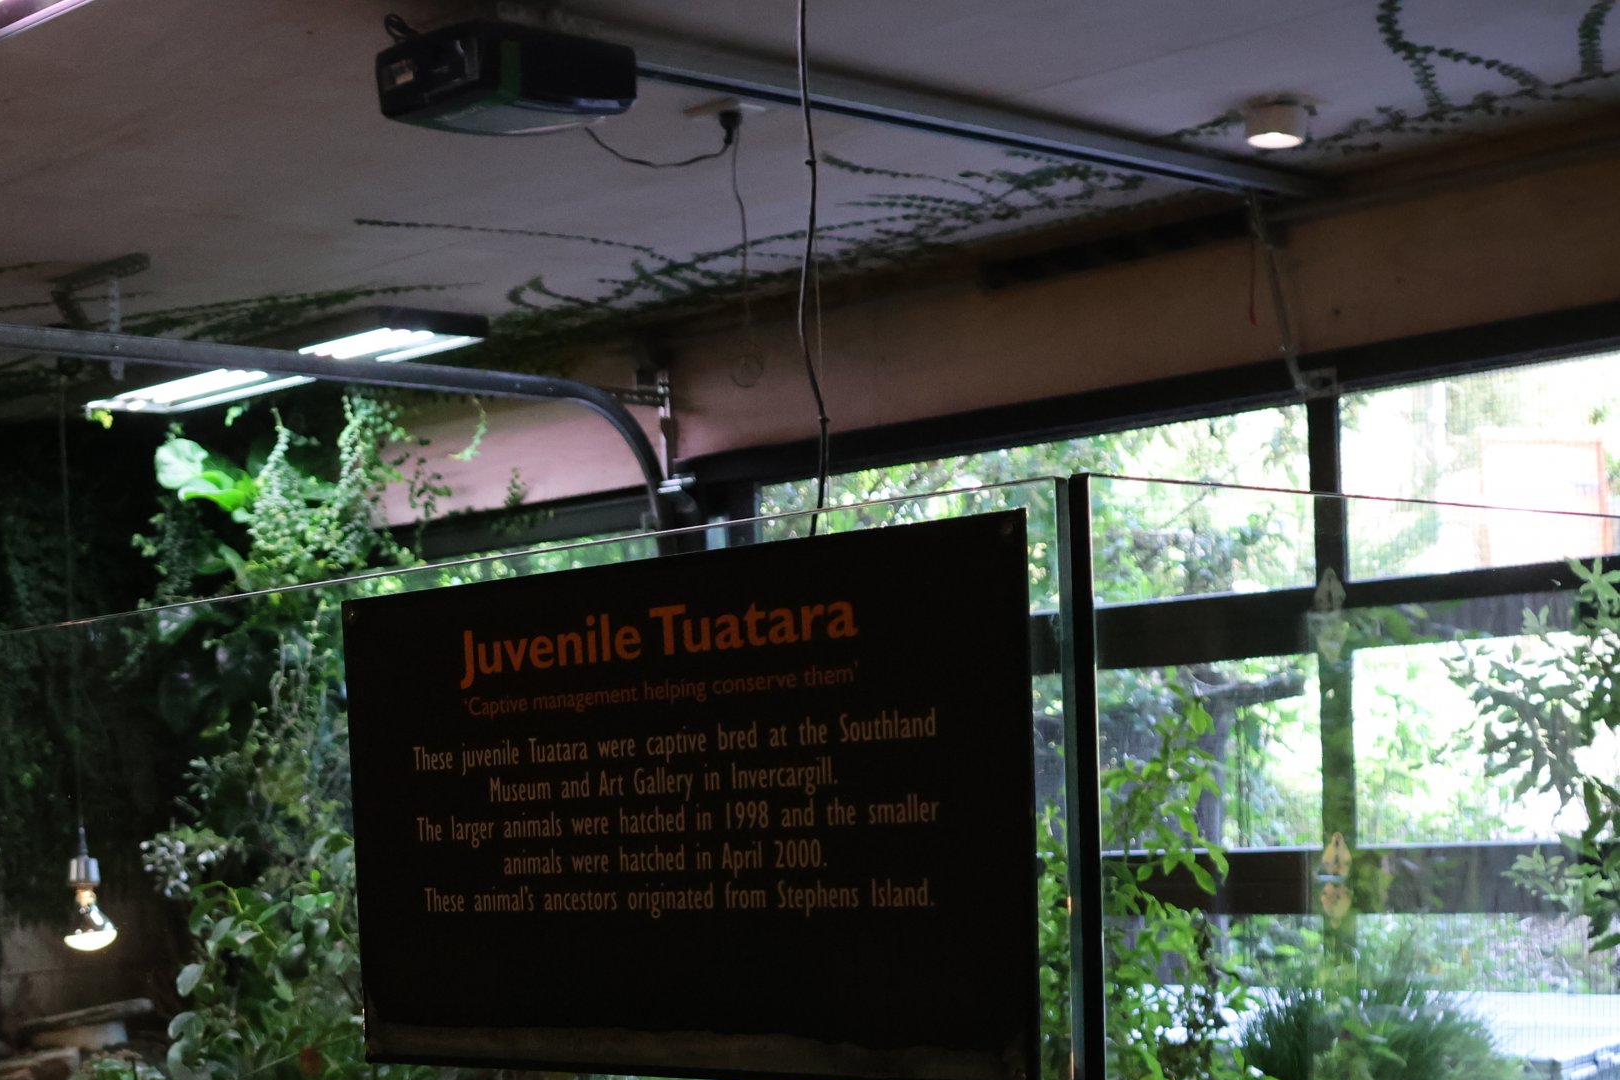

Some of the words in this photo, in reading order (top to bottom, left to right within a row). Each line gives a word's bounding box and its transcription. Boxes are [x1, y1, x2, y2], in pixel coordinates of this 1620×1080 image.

[459, 613, 642, 690] Juvenile
[648, 600, 859, 656] Tuatara
[532, 687, 639, 713] management
[643, 678, 707, 705] helping
[711, 672, 798, 695] conserve
[412, 745, 453, 771] These
[461, 739, 520, 777] juvenile
[527, 737, 589, 764] Tuatara
[596, 737, 636, 758] were
[645, 725, 707, 764] captive
[717, 720, 758, 752] bred
[769, 724, 788, 748] at
[797, 715, 828, 746] the
[839, 706, 937, 743] Southland
[489, 776, 552, 803] Museum
[560, 771, 590, 800] and
[598, 769, 624, 797] Art
[633, 766, 694, 802] Gallery
[704, 763, 721, 792] in
[731, 755, 839, 796] Invercargill.
[416, 816, 443, 842] The
[451, 815, 495, 849] larger
[503, 810, 563, 839] animals
[571, 815, 609, 836] were
[619, 804, 686, 834] hatched
[696, 803, 713, 832] in
[725, 799, 770, 830] 1998
[780, 797, 815, 828] and
[826, 797, 857, 827] the
[868, 793, 939, 825] smaller
[503, 847, 563, 876] animals
[571, 853, 609, 874] were
[619, 843, 685, 873] hatched
[696, 842, 712, 871] in
[721, 840, 763, 879] April
[774, 838, 828, 869] 2000.
[424, 887, 465, 913] These
[473, 885, 535, 913] animal's
[543, 890, 618, 912] ancestors
[627, 882, 714, 919] originated
[724, 880, 767, 910] from
[776, 879, 860, 918] Stephens
[871, 877, 935, 908] Island.
